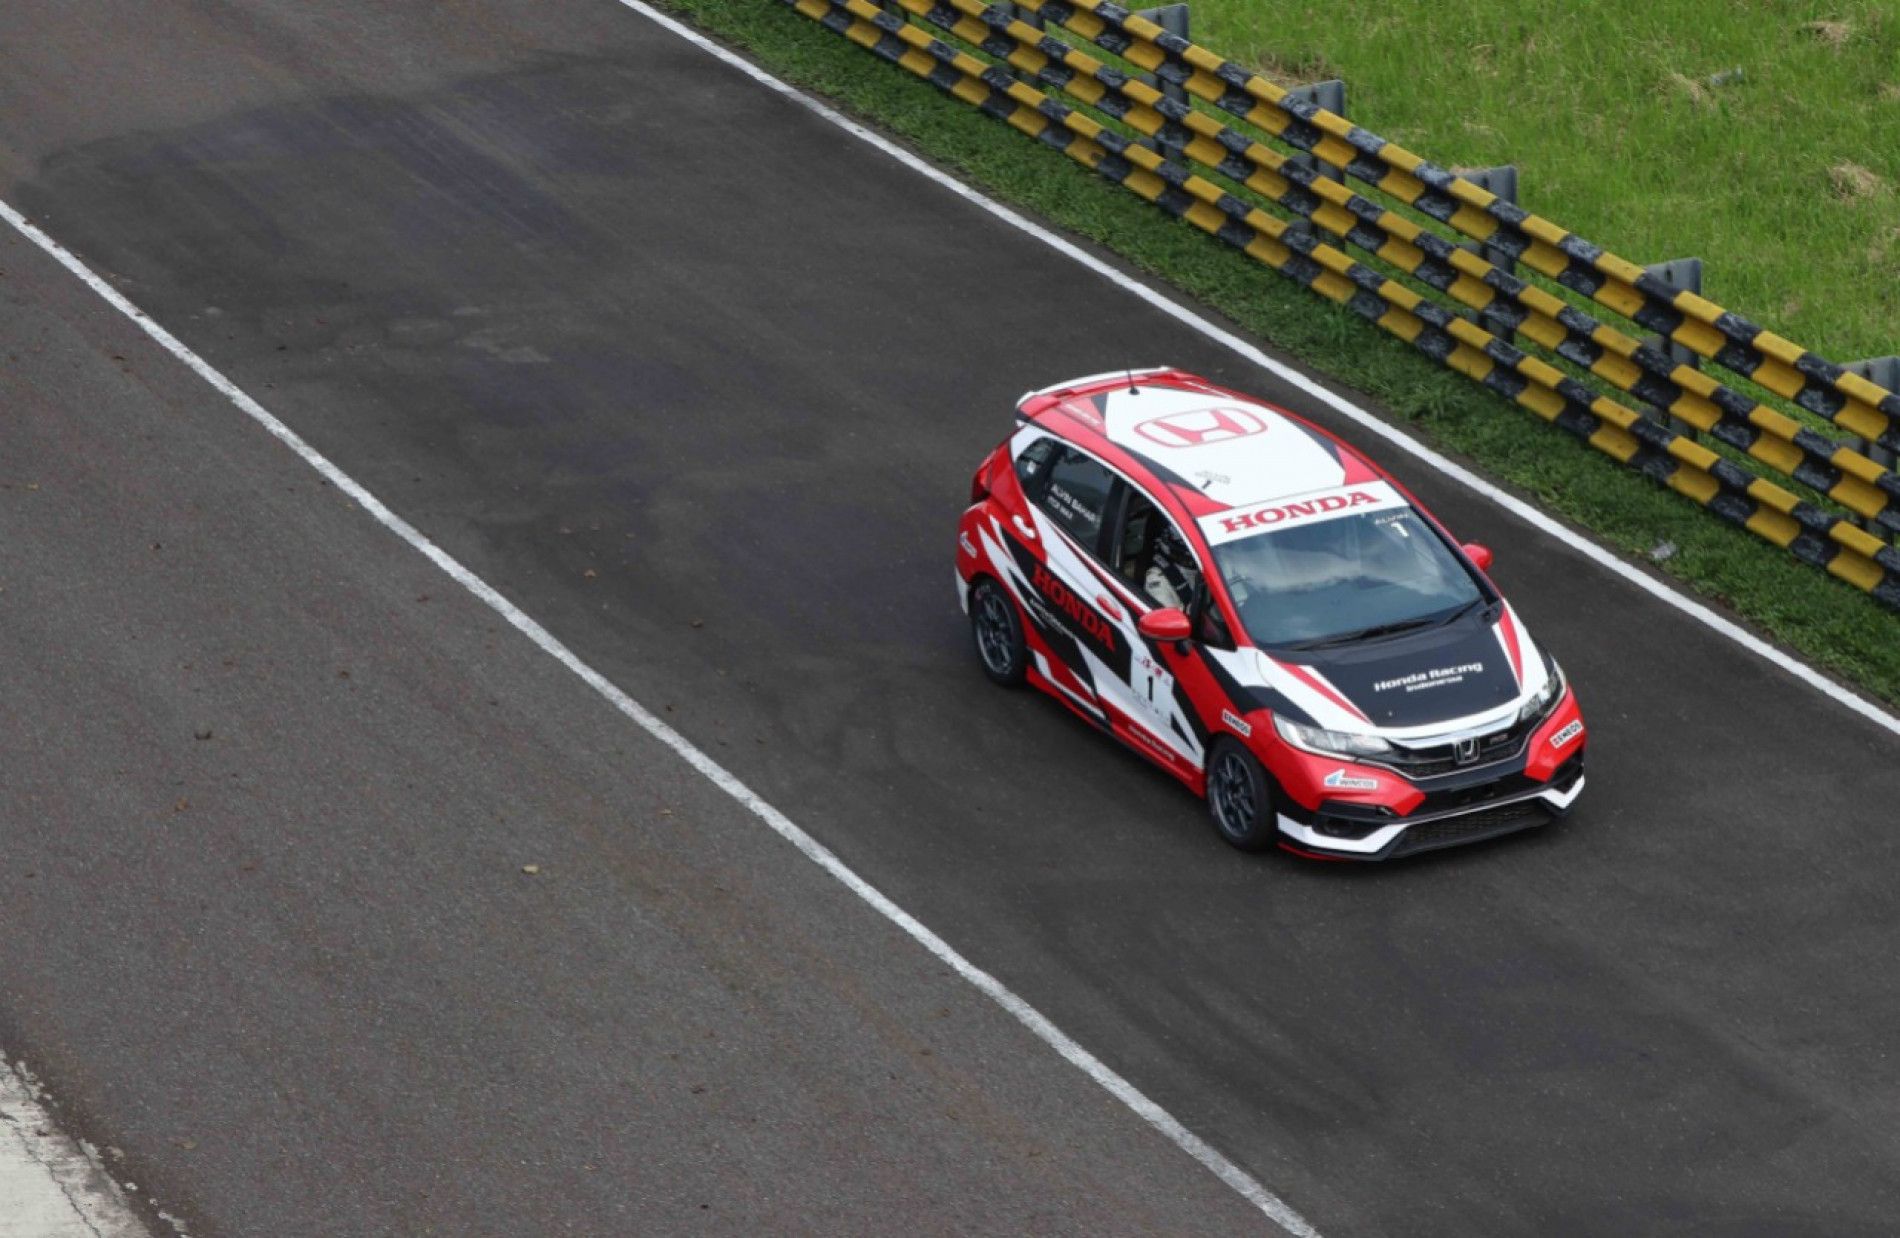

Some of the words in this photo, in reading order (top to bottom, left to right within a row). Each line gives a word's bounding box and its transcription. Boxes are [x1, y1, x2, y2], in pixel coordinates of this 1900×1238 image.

[1218, 490, 1382, 534] HONDA
[1391, 522, 1409, 538] 1
[1032, 562, 1116, 653] HONDA
[1147, 675, 1153, 701] 1
[1374, 673, 1427, 692] Honda
[1428, 662, 1483, 679] Racing
